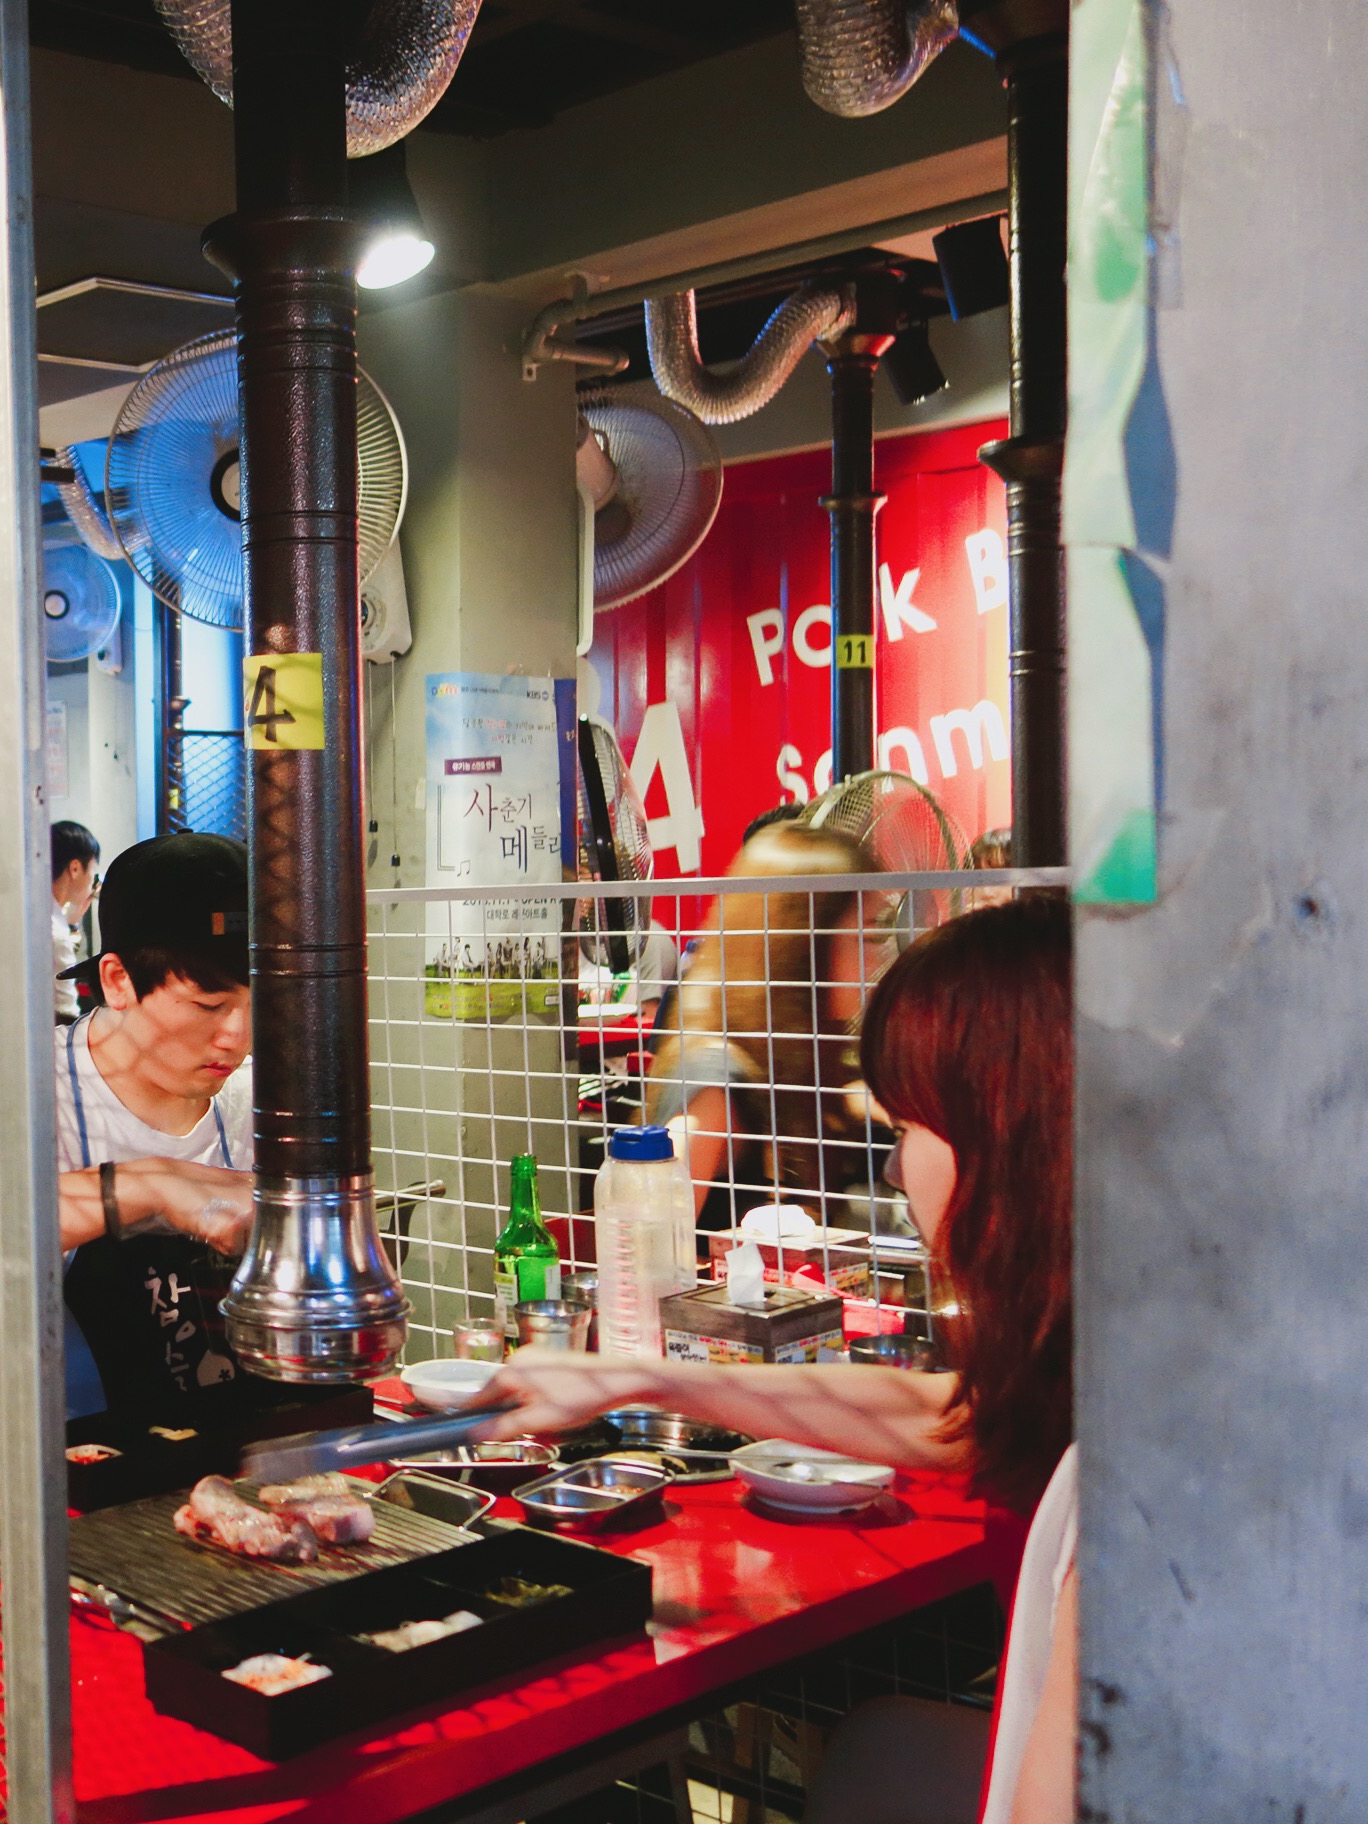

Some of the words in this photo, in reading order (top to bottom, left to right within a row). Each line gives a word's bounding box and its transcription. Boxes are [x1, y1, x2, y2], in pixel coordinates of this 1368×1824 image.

[842, 639, 867, 664] 11
[247, 666, 297, 743] 4
[463, 783, 532, 832] 사춘기
